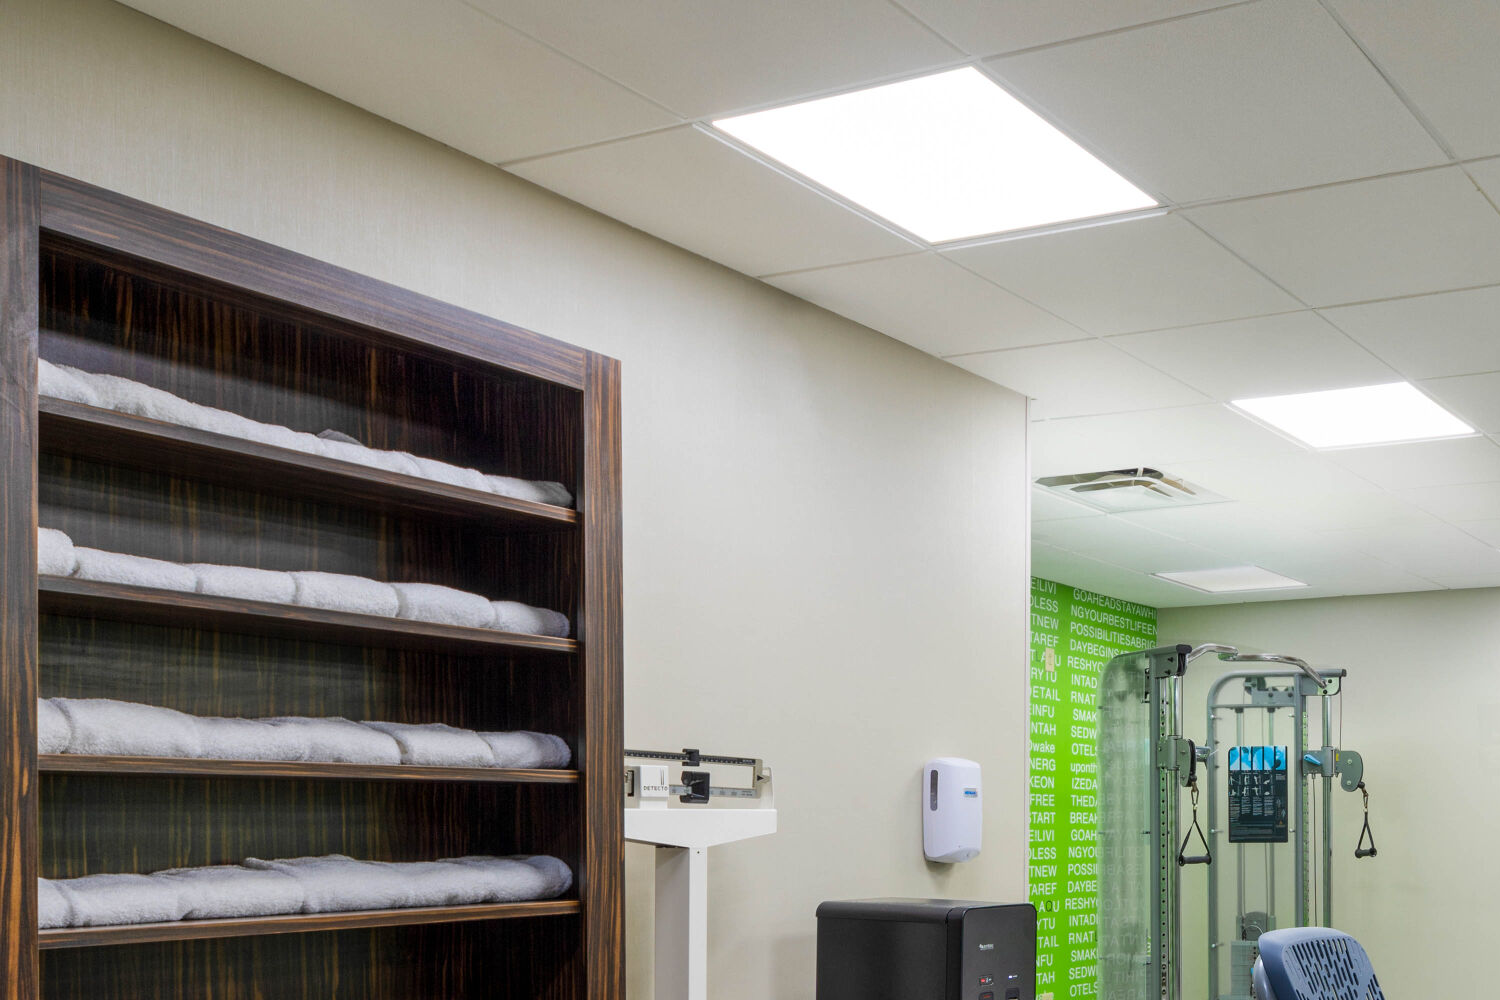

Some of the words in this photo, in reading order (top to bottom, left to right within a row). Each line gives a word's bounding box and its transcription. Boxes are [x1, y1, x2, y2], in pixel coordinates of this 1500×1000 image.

[1071, 673, 1098, 689] INTAD
[1029, 686, 1061, 702] ETAIL
[1029, 704, 1055, 718] INFU
[1030, 793, 1055, 807] FREE
[1029, 865, 1057, 878] TNEW
[1067, 880, 1097, 893] DAYBE
[1037, 935, 1060, 949] TAIL
[1036, 971, 1055, 985] TAH
